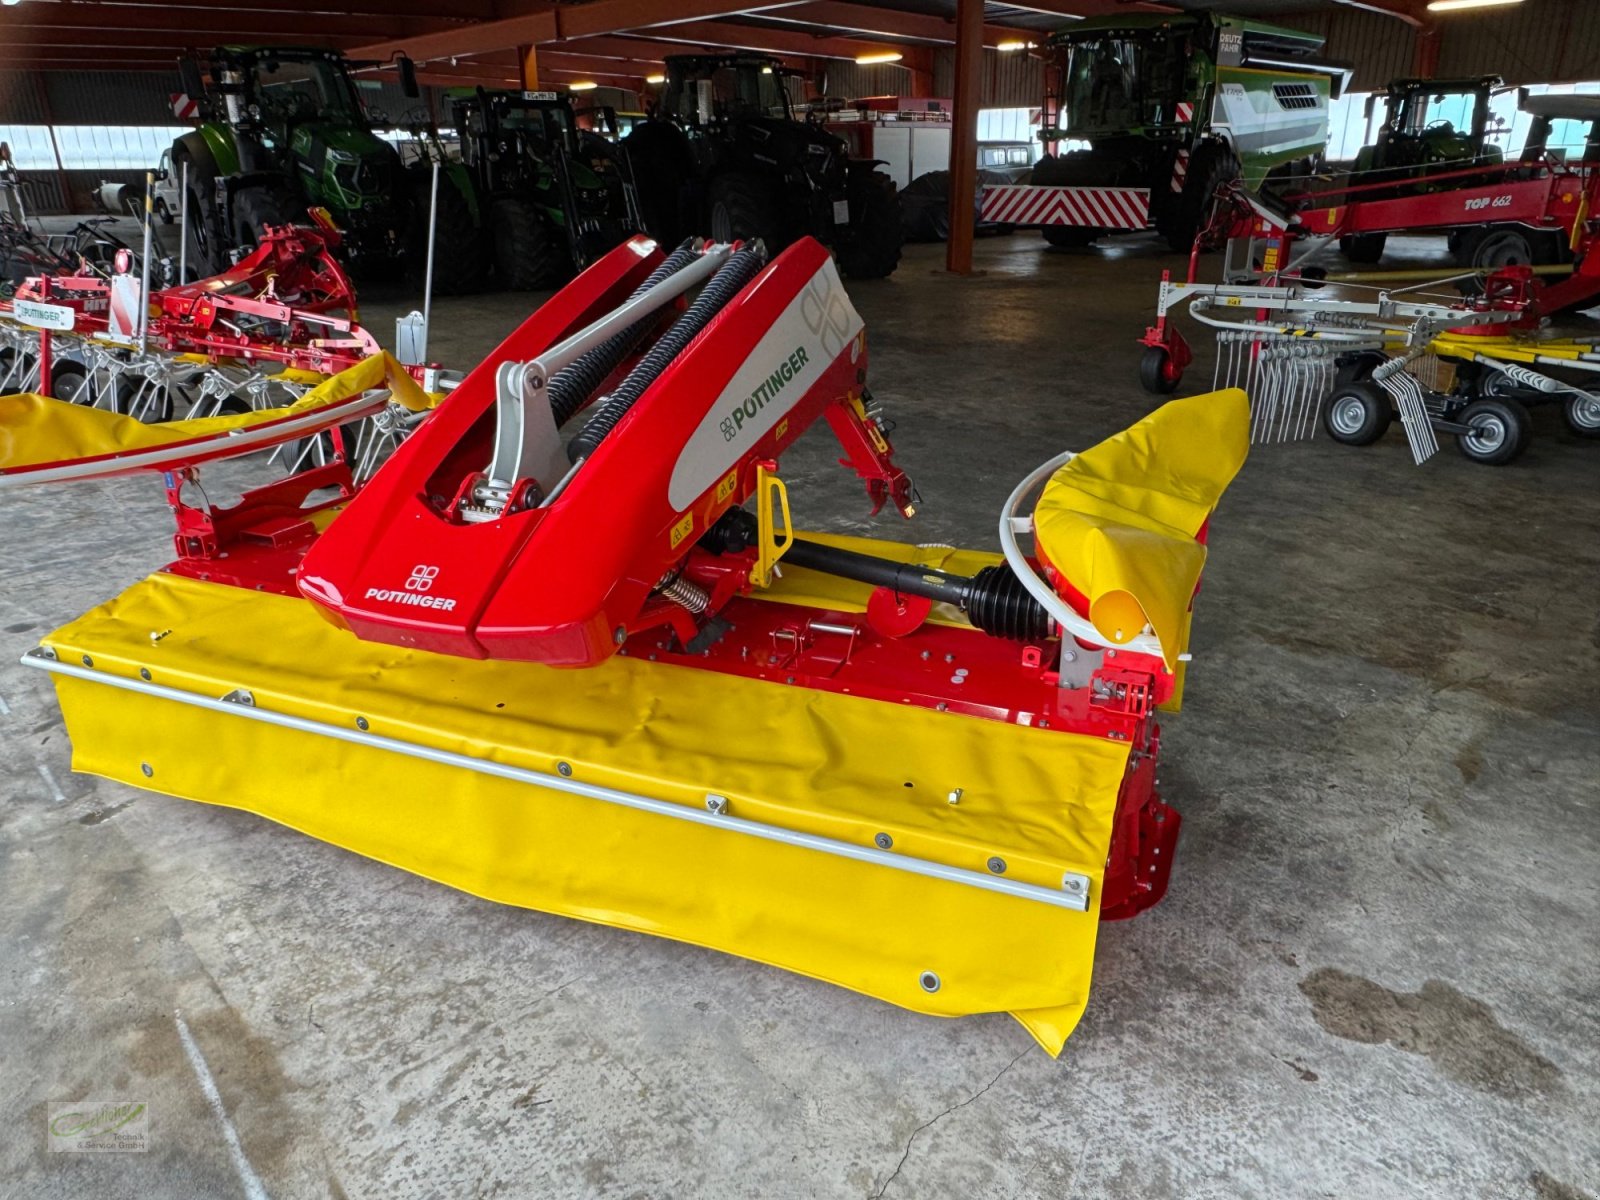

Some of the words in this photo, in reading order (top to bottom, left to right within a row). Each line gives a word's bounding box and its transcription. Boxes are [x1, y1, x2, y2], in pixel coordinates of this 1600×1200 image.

[1220, 33, 1242, 44] DEUTZ
[1220, 43, 1240, 53] FAHR
[1464, 197, 1491, 210] TOP
[1491, 194, 1512, 207] 662
